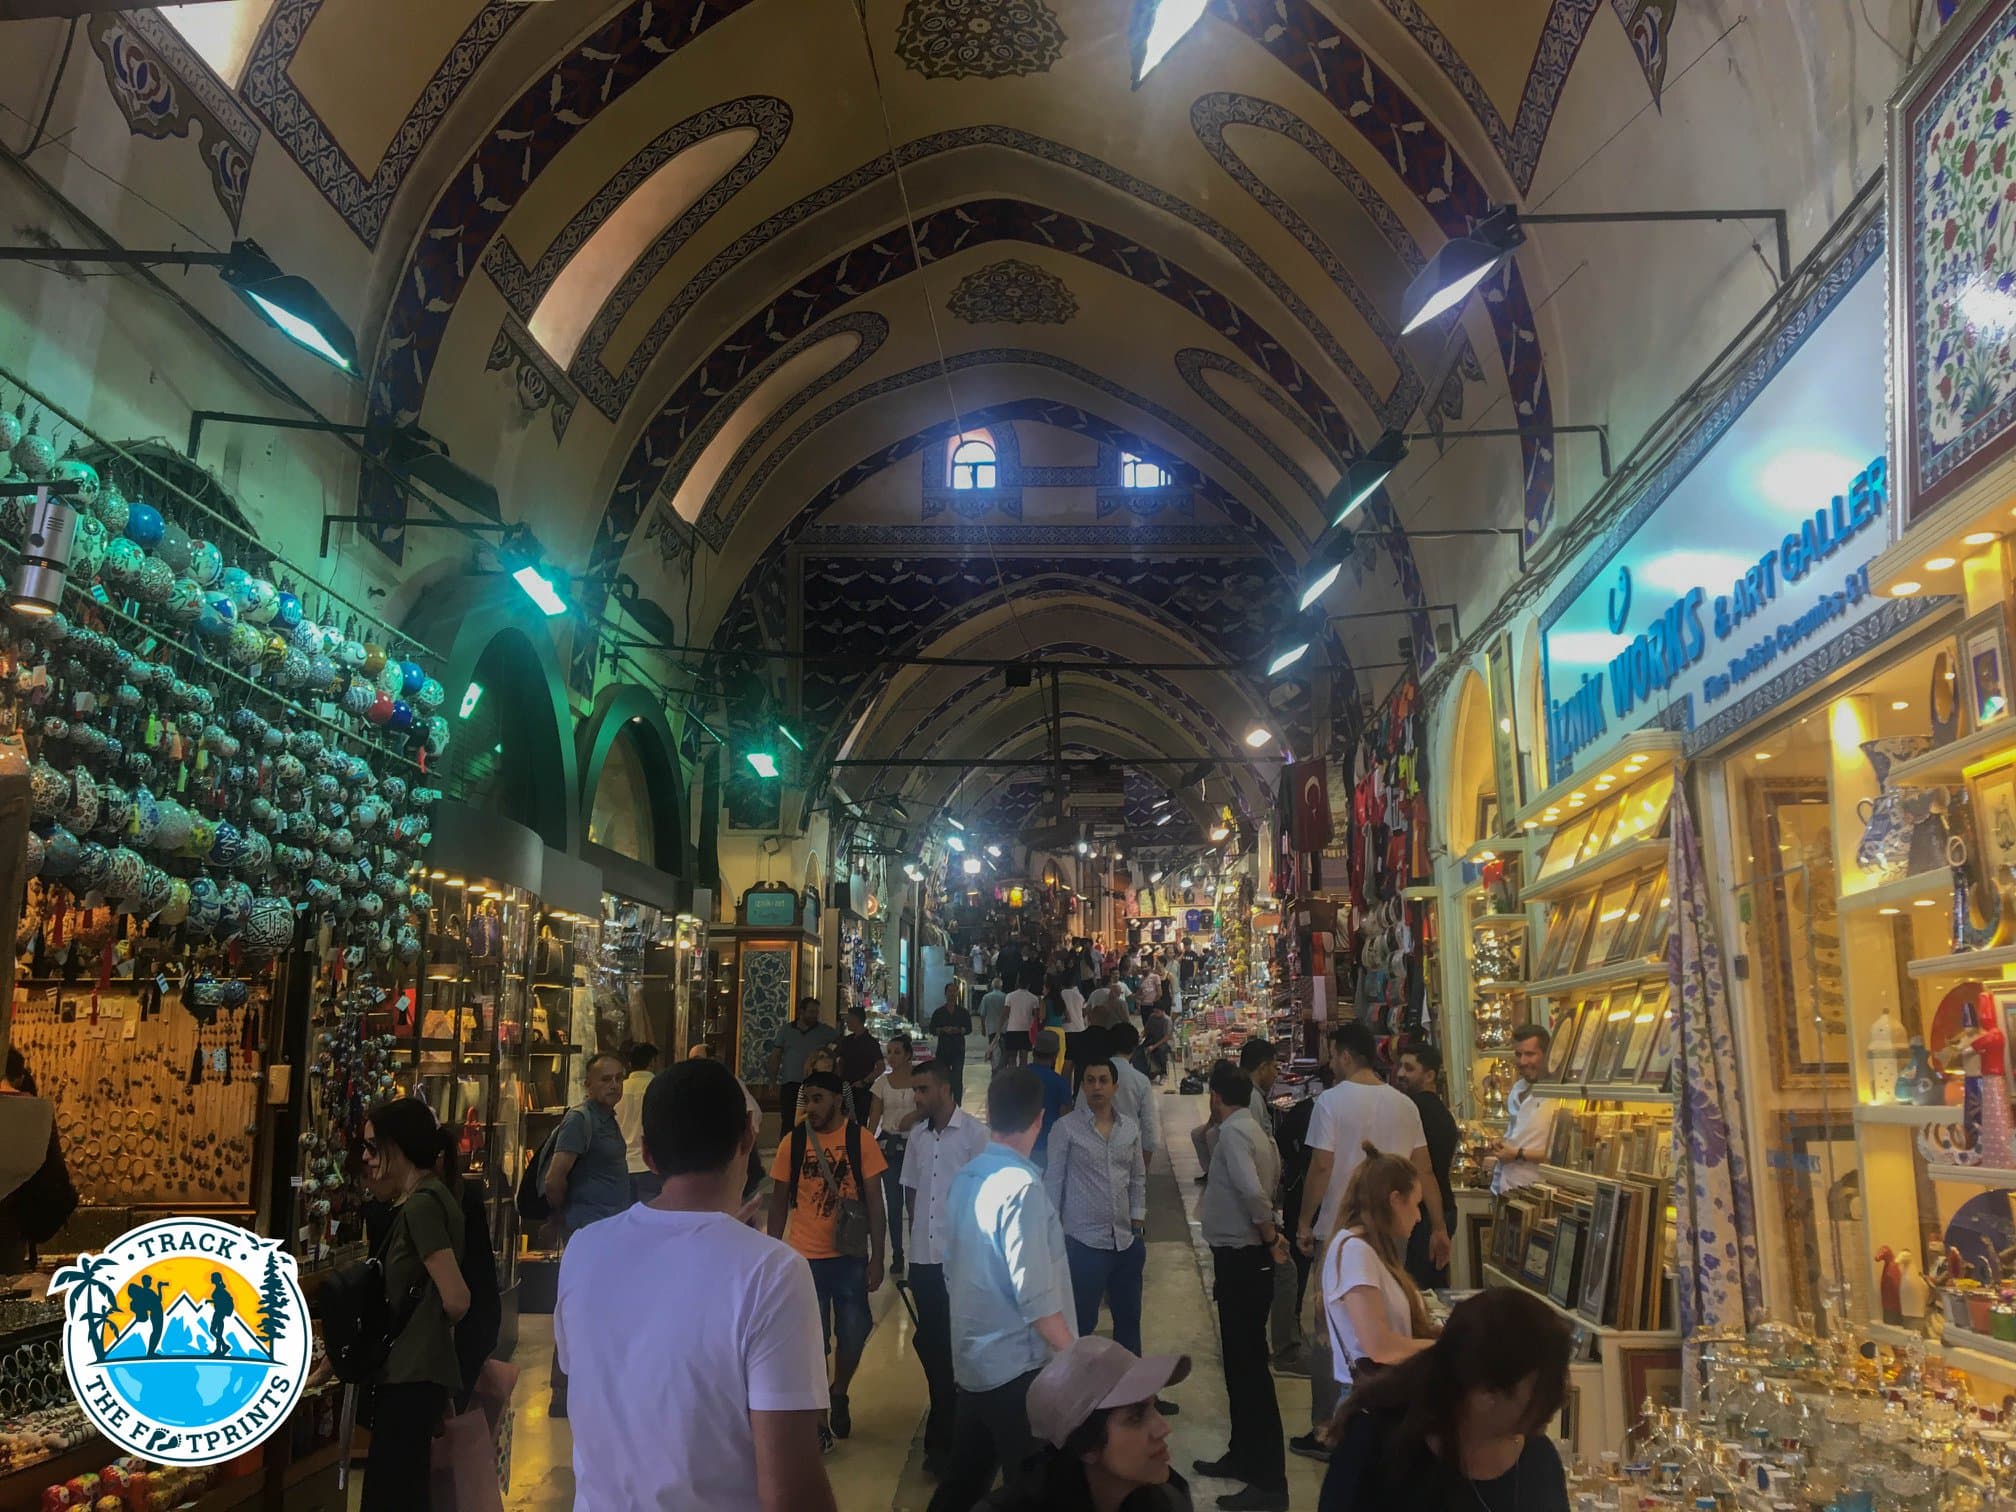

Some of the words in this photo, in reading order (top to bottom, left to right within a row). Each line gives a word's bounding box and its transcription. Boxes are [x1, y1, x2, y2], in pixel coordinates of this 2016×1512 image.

[1609, 587, 1706, 718] WORKS
[1714, 595, 1733, 640] &
[1731, 549, 1779, 627] ART
